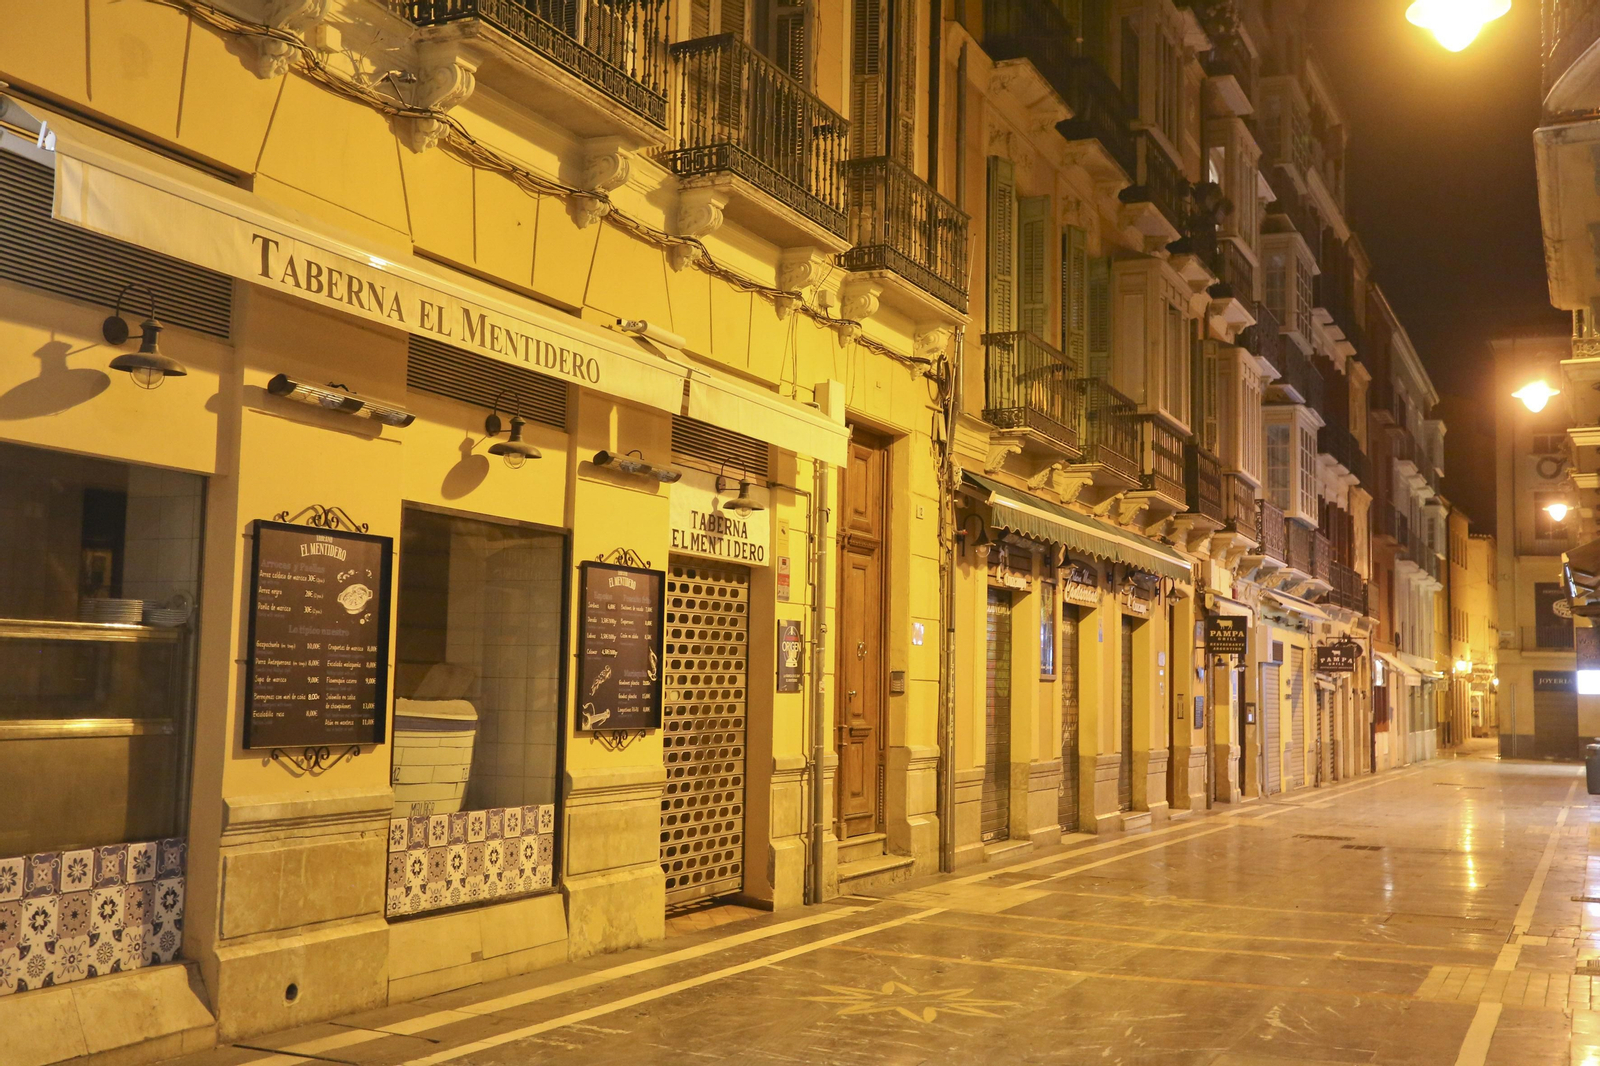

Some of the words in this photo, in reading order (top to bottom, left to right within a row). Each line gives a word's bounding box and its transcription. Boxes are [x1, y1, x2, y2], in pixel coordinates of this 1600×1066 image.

[252, 233, 406, 323] TABERNA
[418, 299, 452, 338] EL
[460, 306, 601, 384] MENTIDERO
[691, 510, 748, 539] TABERNA
[300, 544, 310, 557] EL
[310, 543, 347, 562] MENTIDERO
[672, 529, 689, 549] EL
[689, 532, 765, 562] MENTIDERO
[1210, 630, 1245, 638] PAMPA
[782, 641, 803, 653] ORIGEN
[1320, 656, 1353, 664] PAMPA
